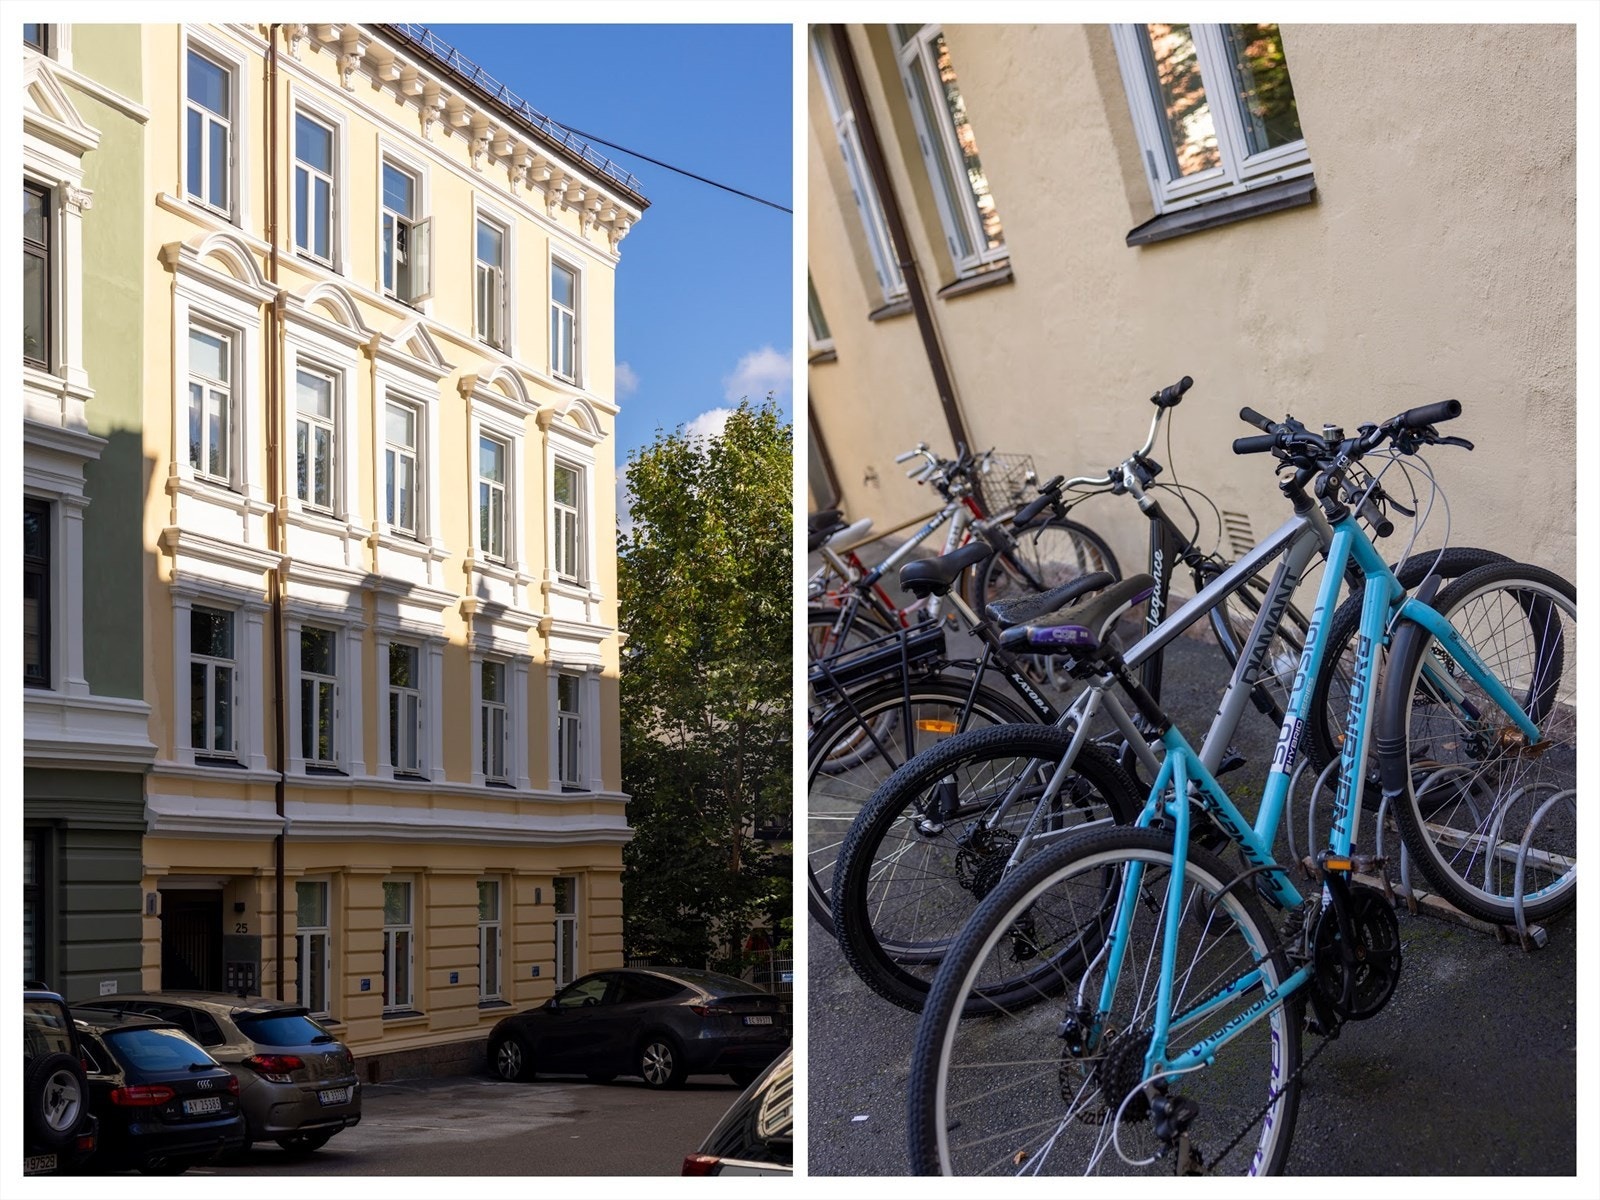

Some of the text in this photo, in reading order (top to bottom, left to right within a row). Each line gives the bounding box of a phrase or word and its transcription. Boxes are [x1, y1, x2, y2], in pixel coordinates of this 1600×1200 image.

[1145, 549, 1164, 631] legance
[1240, 566, 1298, 685] DIAMANT
[1011, 673, 1050, 714] KAYOBA
[1288, 677, 1314, 764] HYBRID SERIES
[1332, 634, 1372, 835] NAKAMURA
[235, 922, 248, 934] 25
